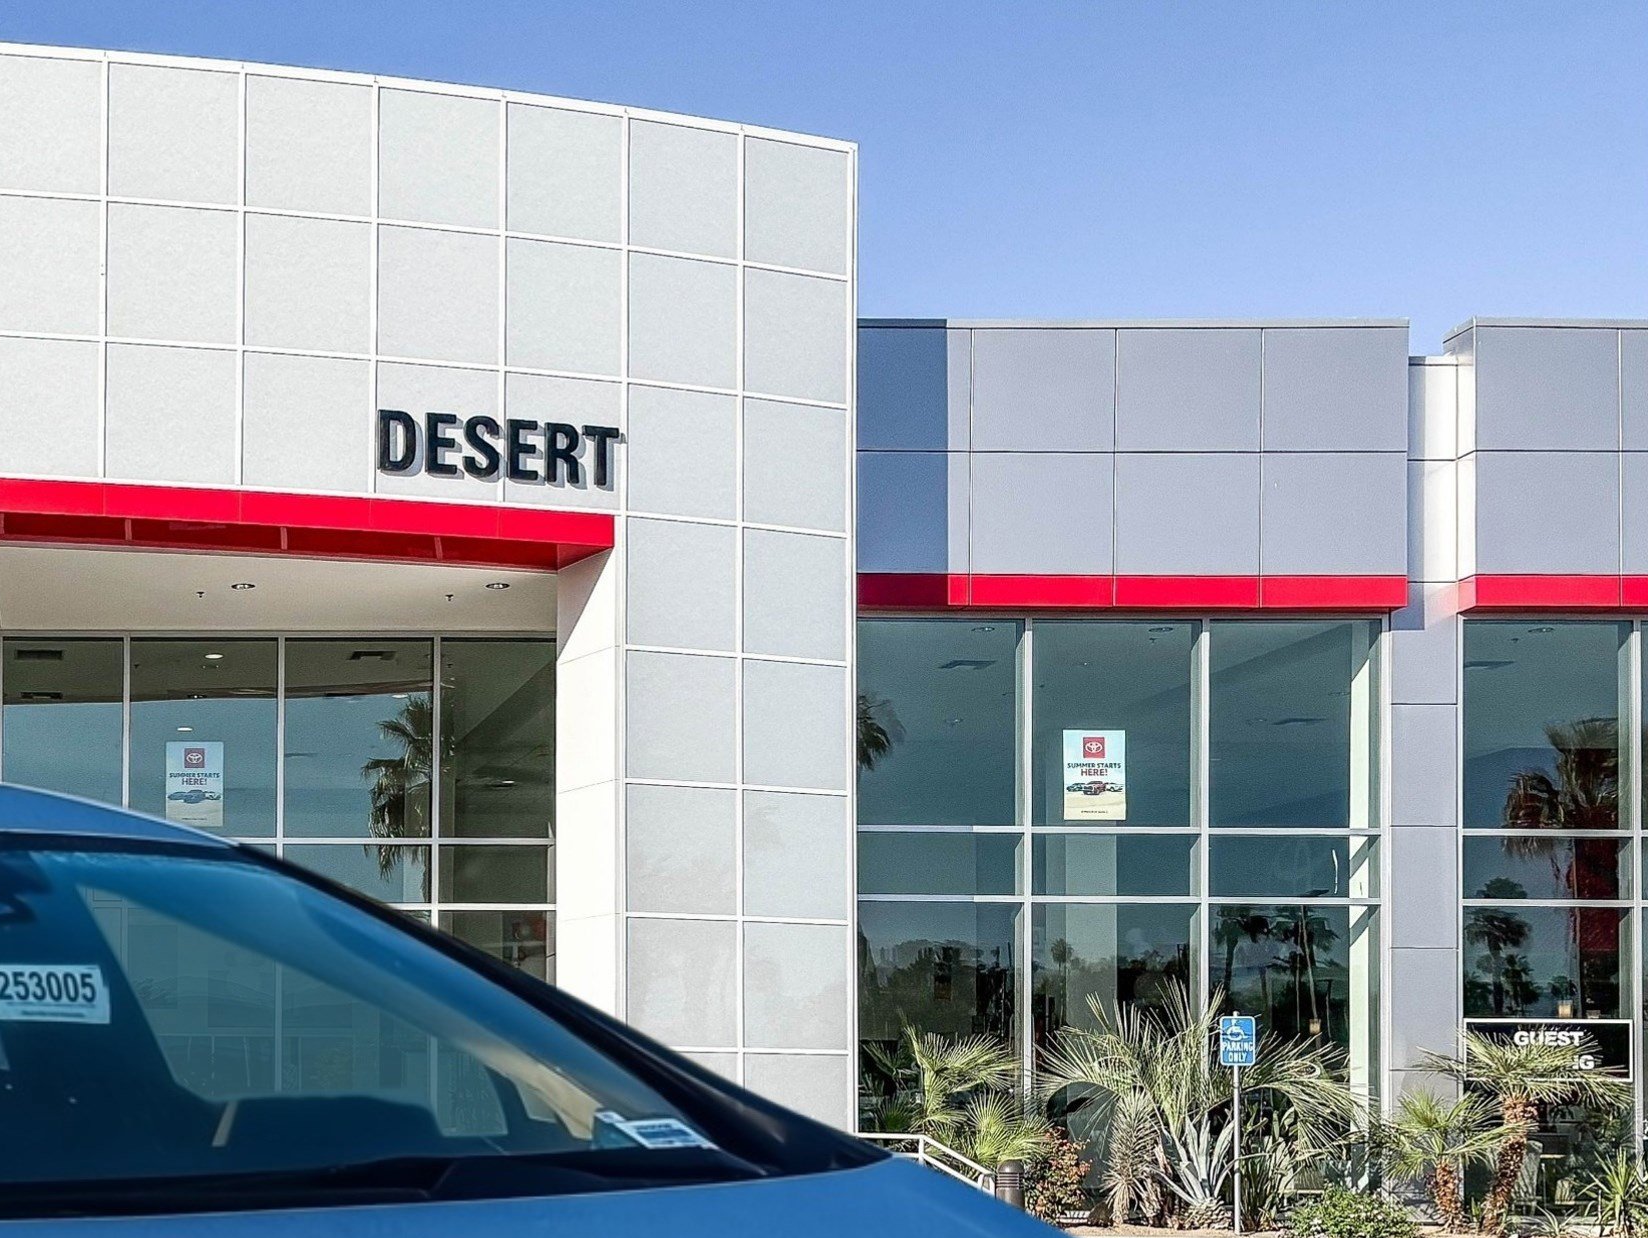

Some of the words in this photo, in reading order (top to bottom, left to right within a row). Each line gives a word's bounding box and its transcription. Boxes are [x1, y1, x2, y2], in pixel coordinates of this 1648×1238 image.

[377, 409, 620, 487] DESERT
[1080, 768, 1108, 777] HERE!
[181, 778, 208, 786] HERE!
[1513, 1030, 1585, 1047] GUEST
[1222, 1041, 1253, 1052] PARKING
[1228, 1052, 1247, 1063] ONLY
